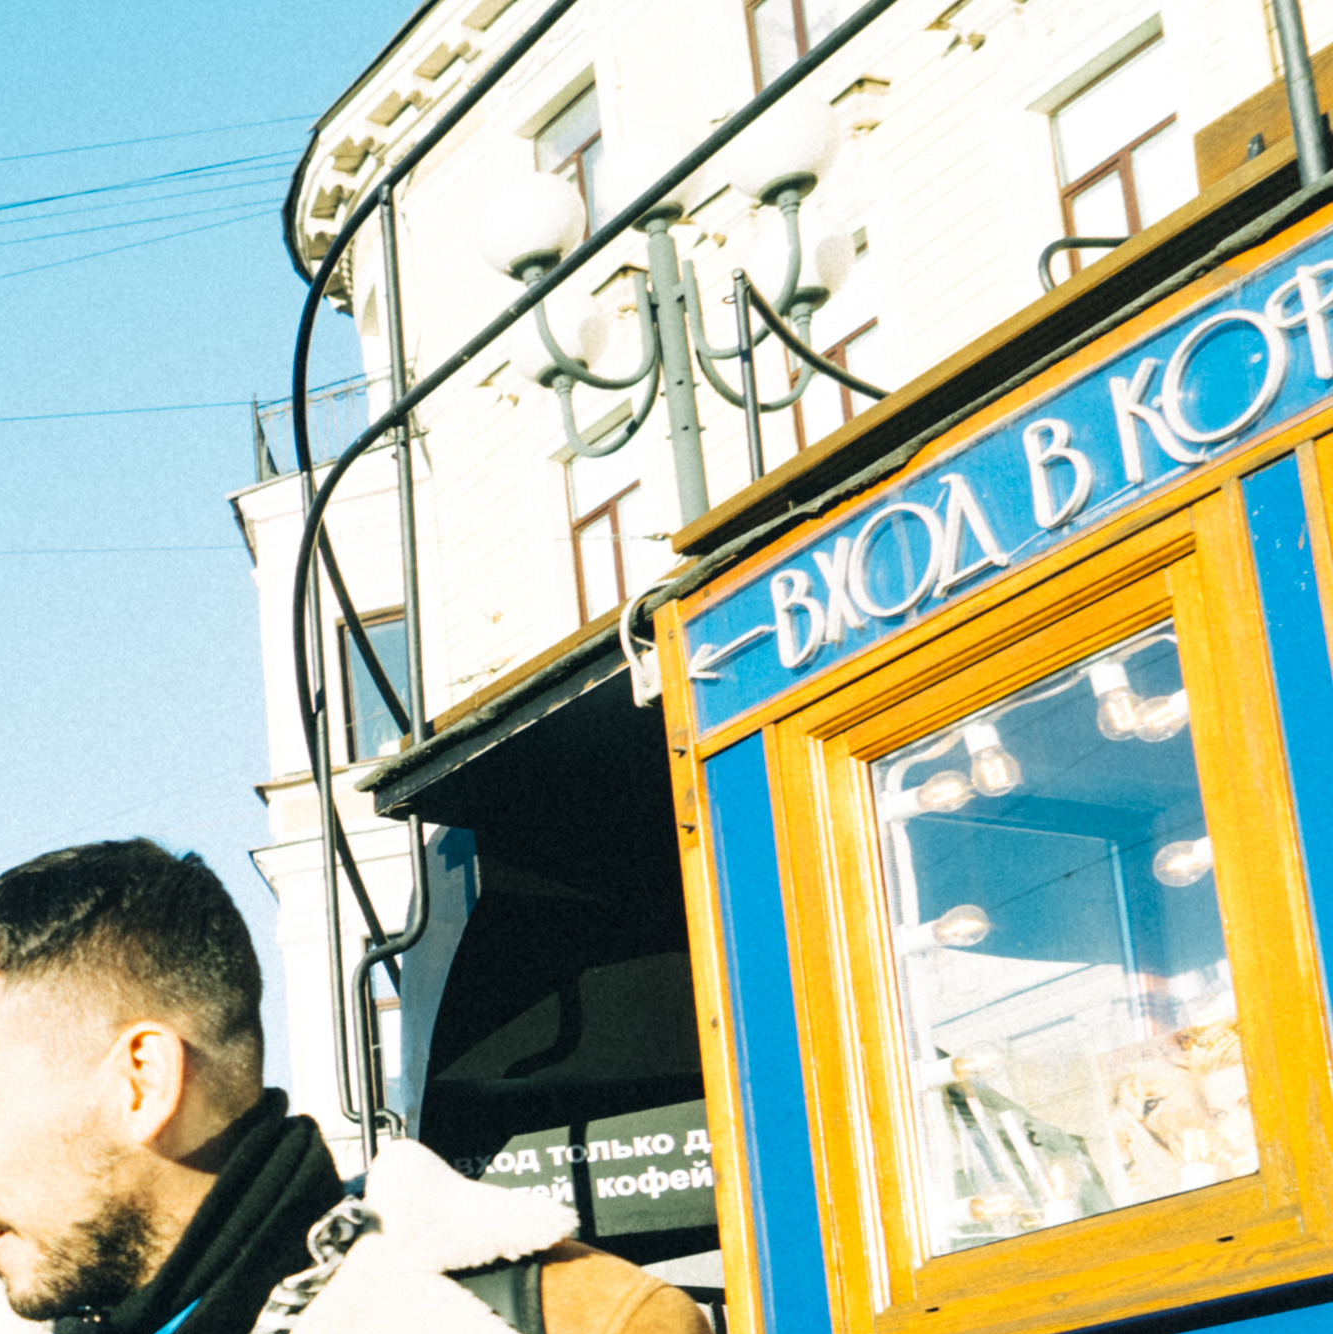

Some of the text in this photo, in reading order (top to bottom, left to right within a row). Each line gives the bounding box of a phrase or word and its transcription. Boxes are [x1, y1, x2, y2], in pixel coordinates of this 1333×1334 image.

[770, 259, 1333, 668] ВХОД В КОФ
[546, 1133, 675, 1166] только
[596, 1160, 714, 1199] кофей
